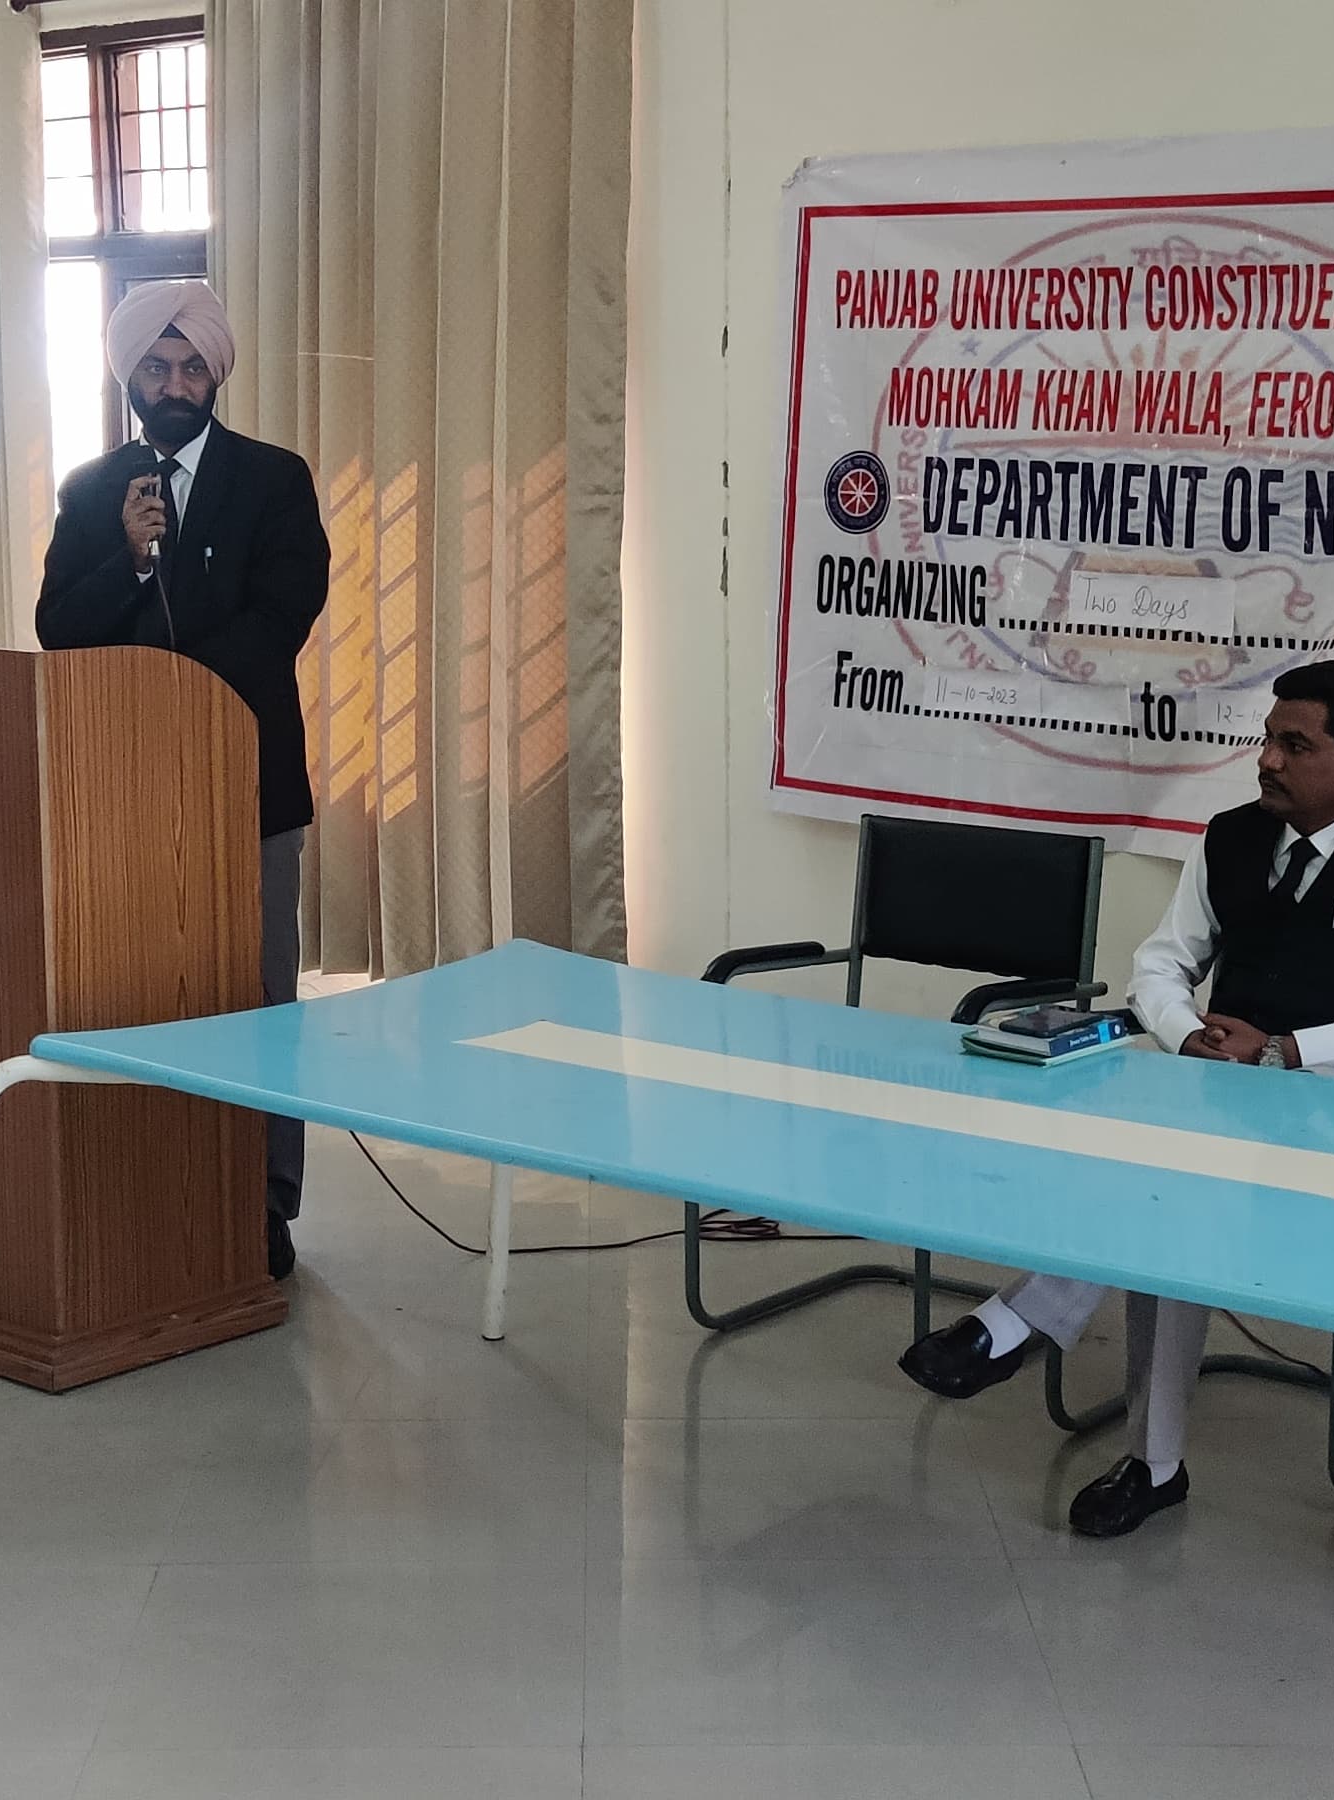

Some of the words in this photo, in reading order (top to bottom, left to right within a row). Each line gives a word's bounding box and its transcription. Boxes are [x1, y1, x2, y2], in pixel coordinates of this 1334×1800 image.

[835, 267, 939, 331] PANJAB
[950, 266, 1134, 331] UNIVERSITY
[887, 367, 1023, 431] MOHKAM
[1031, 369, 1123, 432] KHAN
[1133, 370, 1232, 447] WALA,
[922, 454, 1208, 551] DEPARTMENT
[1222, 466, 1282, 553] OF
[816, 554, 988, 628] ORGANIZING
[1131, 584, 1189, 626] Days
[832, 650, 905, 714] From
[1140, 680, 1177, 741] to
